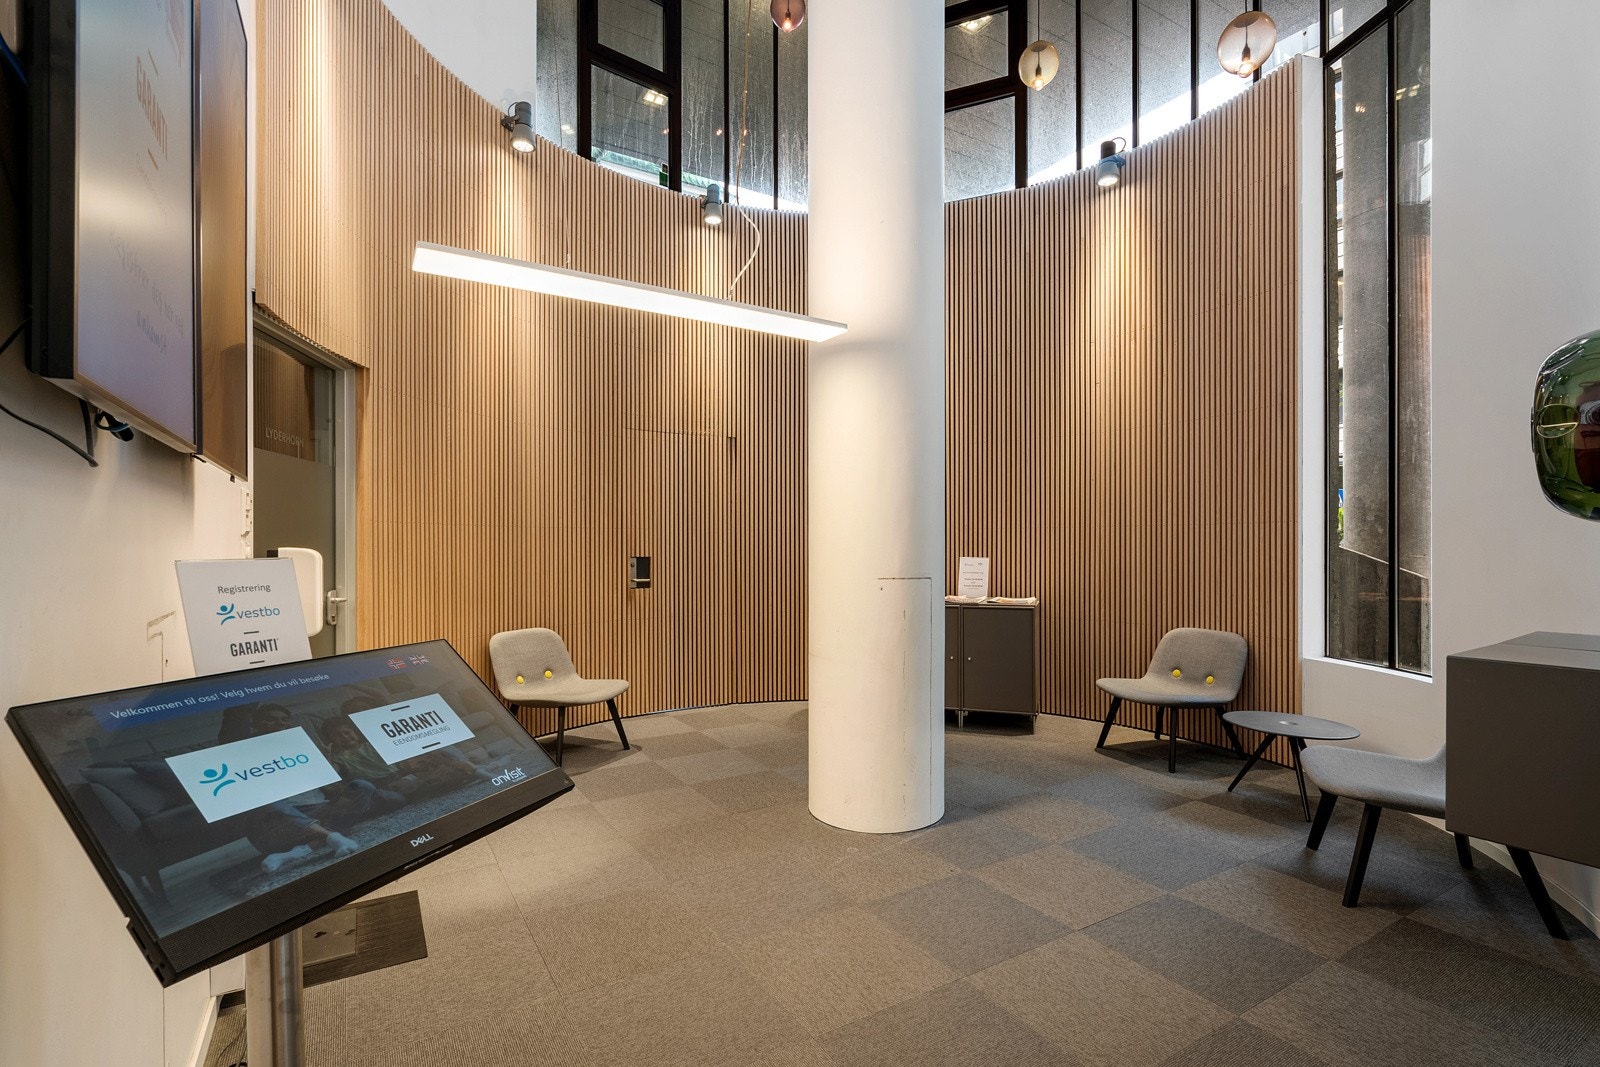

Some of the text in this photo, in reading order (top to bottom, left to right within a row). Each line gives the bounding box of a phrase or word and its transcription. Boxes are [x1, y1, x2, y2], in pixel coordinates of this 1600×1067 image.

[136, 55, 168, 161] GARANTI
[217, 583, 272, 595] Registrering
[236, 606, 281, 619] vestbo
[229, 638, 279, 657] GARANTI
[109, 673, 330, 719] Velkommen til oss! Velg hvem du vil besøke
[380, 710, 445, 738] GARANTI
[392, 725, 451, 746] EIENDOMSMEGLING
[235, 754, 309, 781] vestbo
[410, 833, 434, 848] DELL
